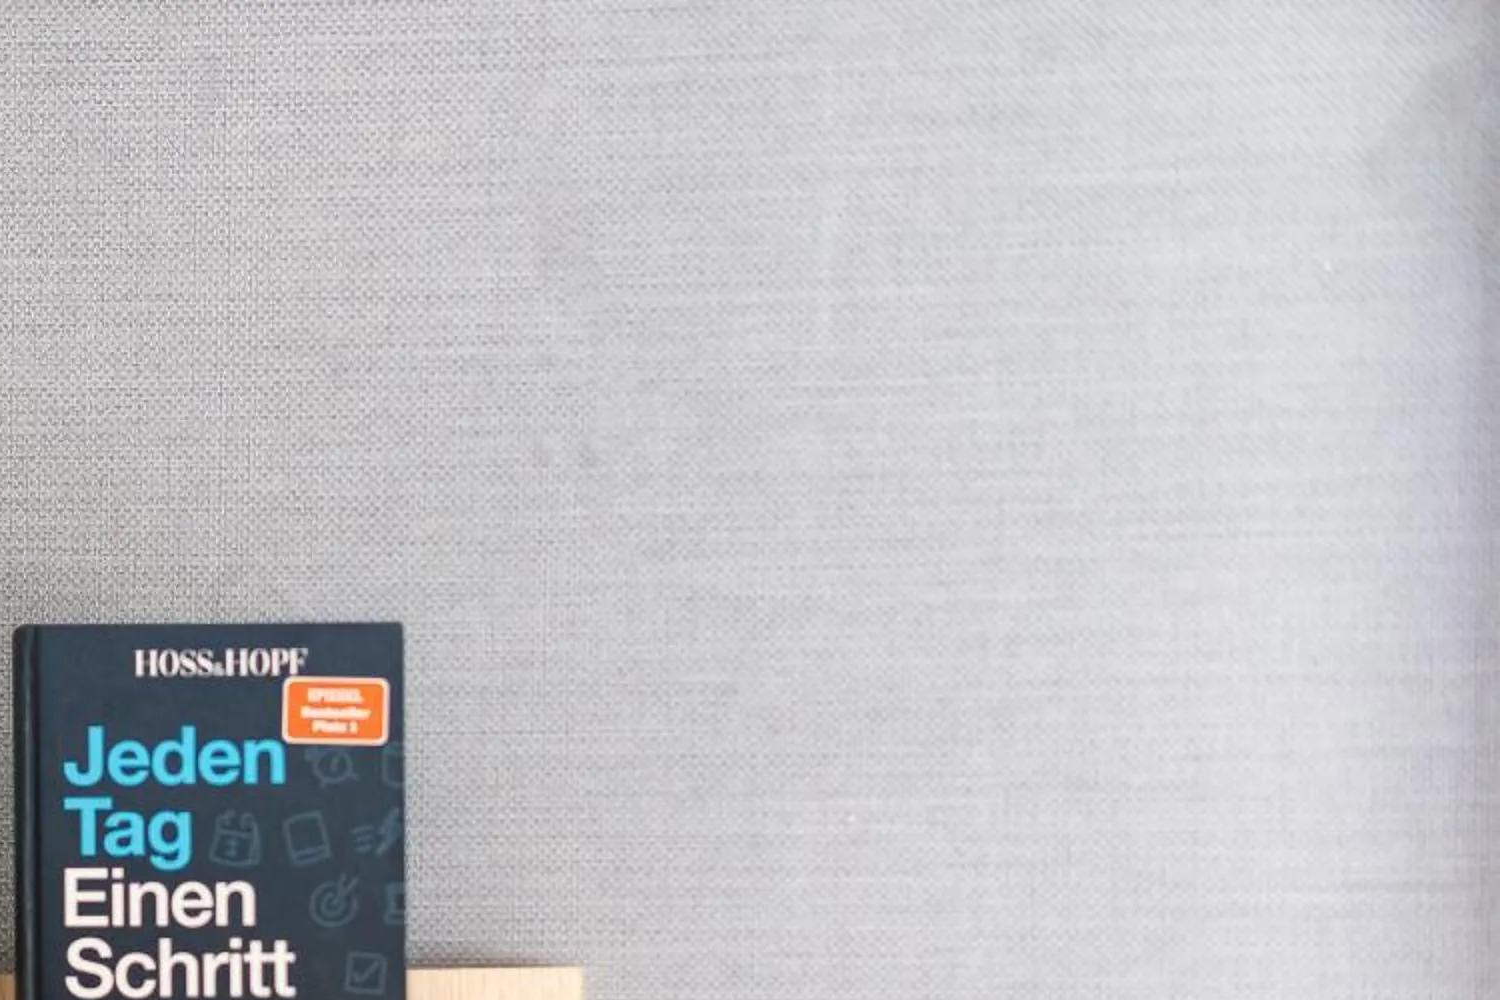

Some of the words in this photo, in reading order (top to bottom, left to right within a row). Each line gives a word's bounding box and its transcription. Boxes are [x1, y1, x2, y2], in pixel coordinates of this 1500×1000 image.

[63, 726, 286, 786] Jeden
[63, 796, 193, 870] Tag
[64, 867, 256, 928] Einen
[65, 937, 296, 999] Schritt
